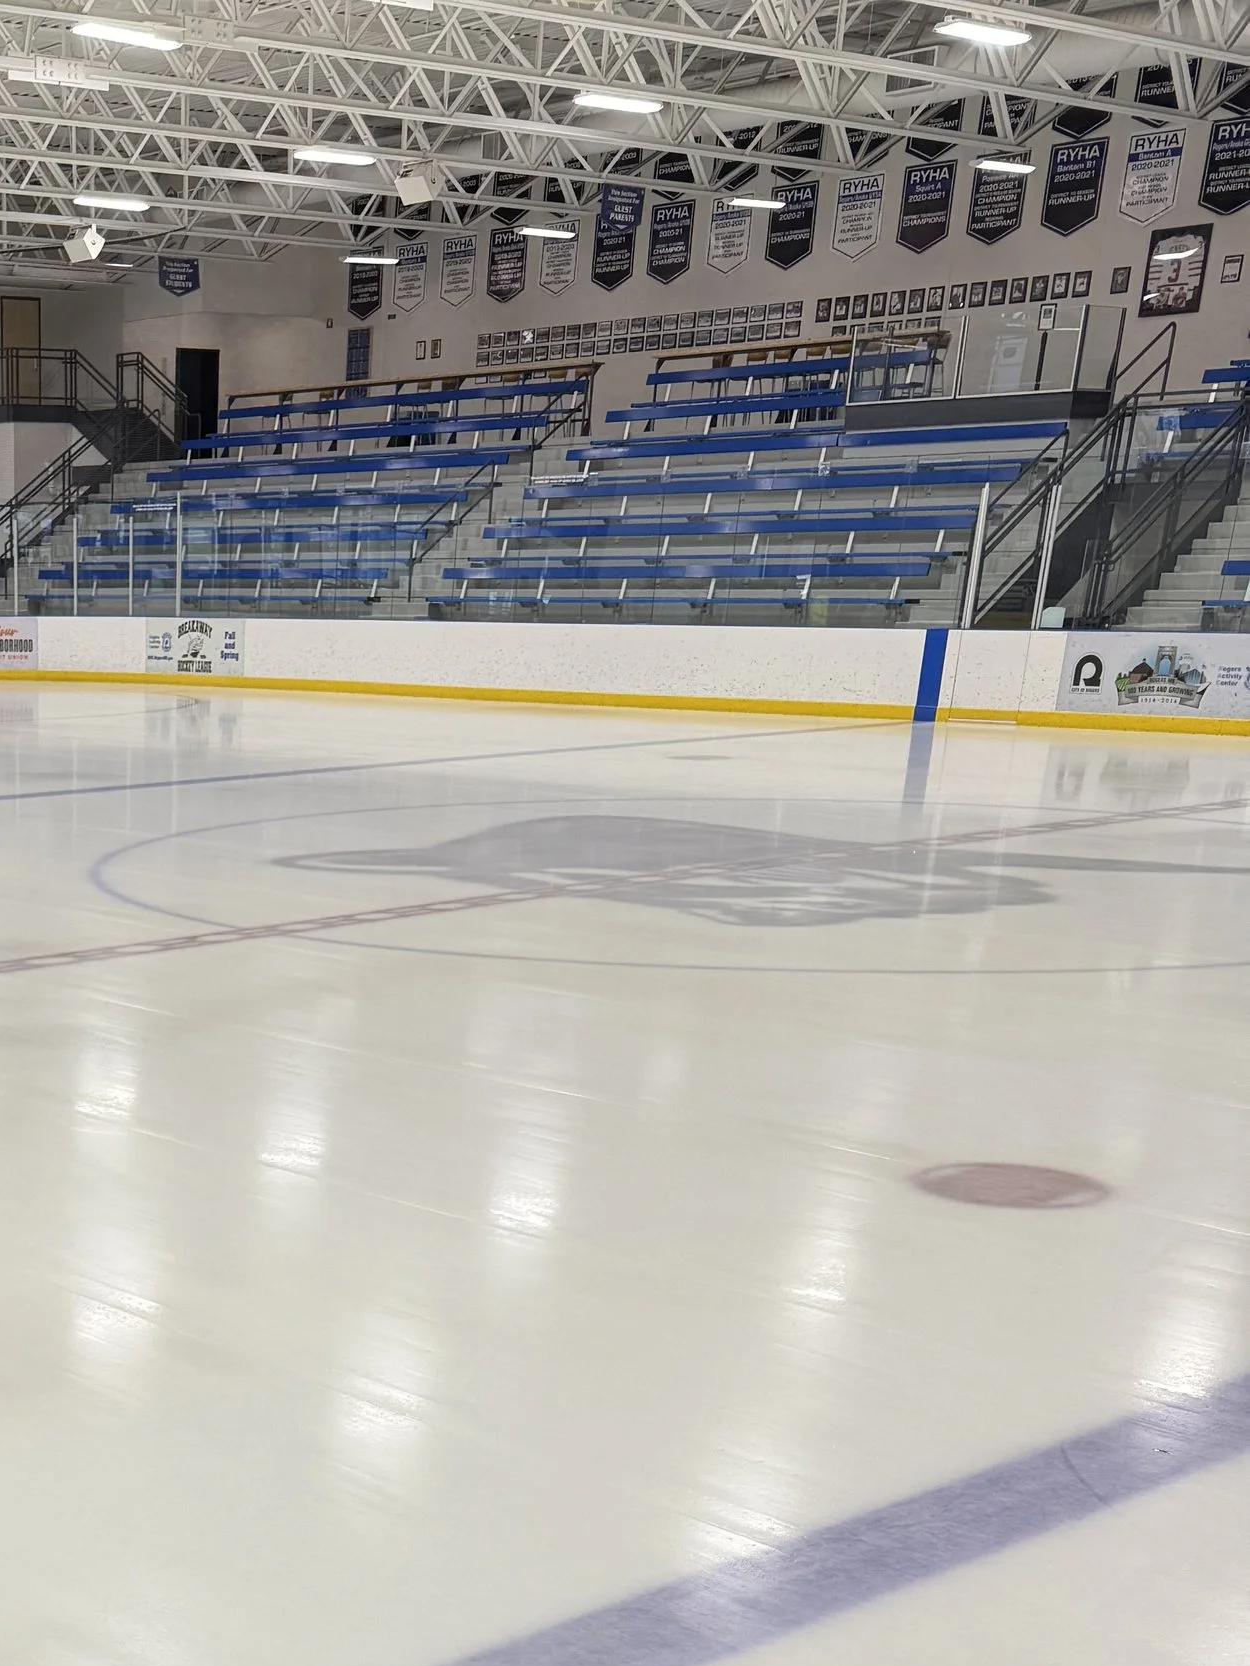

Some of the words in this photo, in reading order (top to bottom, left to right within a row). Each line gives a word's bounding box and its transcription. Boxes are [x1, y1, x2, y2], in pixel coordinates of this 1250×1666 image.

[1134, 133, 1179, 152] RYHA
[1057, 144, 1100, 163] RYHA
[1139, 151, 1165, 160] Bantam
[1057, 163, 1085, 173] Bantam
[910, 167, 949, 184] RYHA
[1132, 176, 1169, 186] CHAMPION
[842, 178, 880, 194] RYHA
[915, 184, 934, 193] Squirt
[777, 188, 812, 202] RYHA
[978, 194, 1017, 205] CHAMPION
[1048, 194, 1096, 206] RUNNER-UP
[657, 206, 689, 221] RYHA
[975, 206, 1017, 217] RUNNER-UP
[902, 216, 946, 227] CHAMPIONS
[971, 219, 1017, 230] PARTICIPANT
[495, 231, 523, 244] RYHA
[770, 233, 810, 243] CHAMPIONS
[446, 240, 473, 251] RYHA
[653, 246, 685, 255] CHAMPION
[399, 246, 425, 257] RYHA
[653, 257, 685, 266] CHAMPION
[178, 620, 212, 639] BREAKAWAY
[224, 631, 235, 640] Fall
[220, 650, 239, 661] Spring
[178, 660, 194, 672] HOCKEY
[195, 660, 212, 673] LEAGUE
[1169, 686, 1194, 695] GROWING
